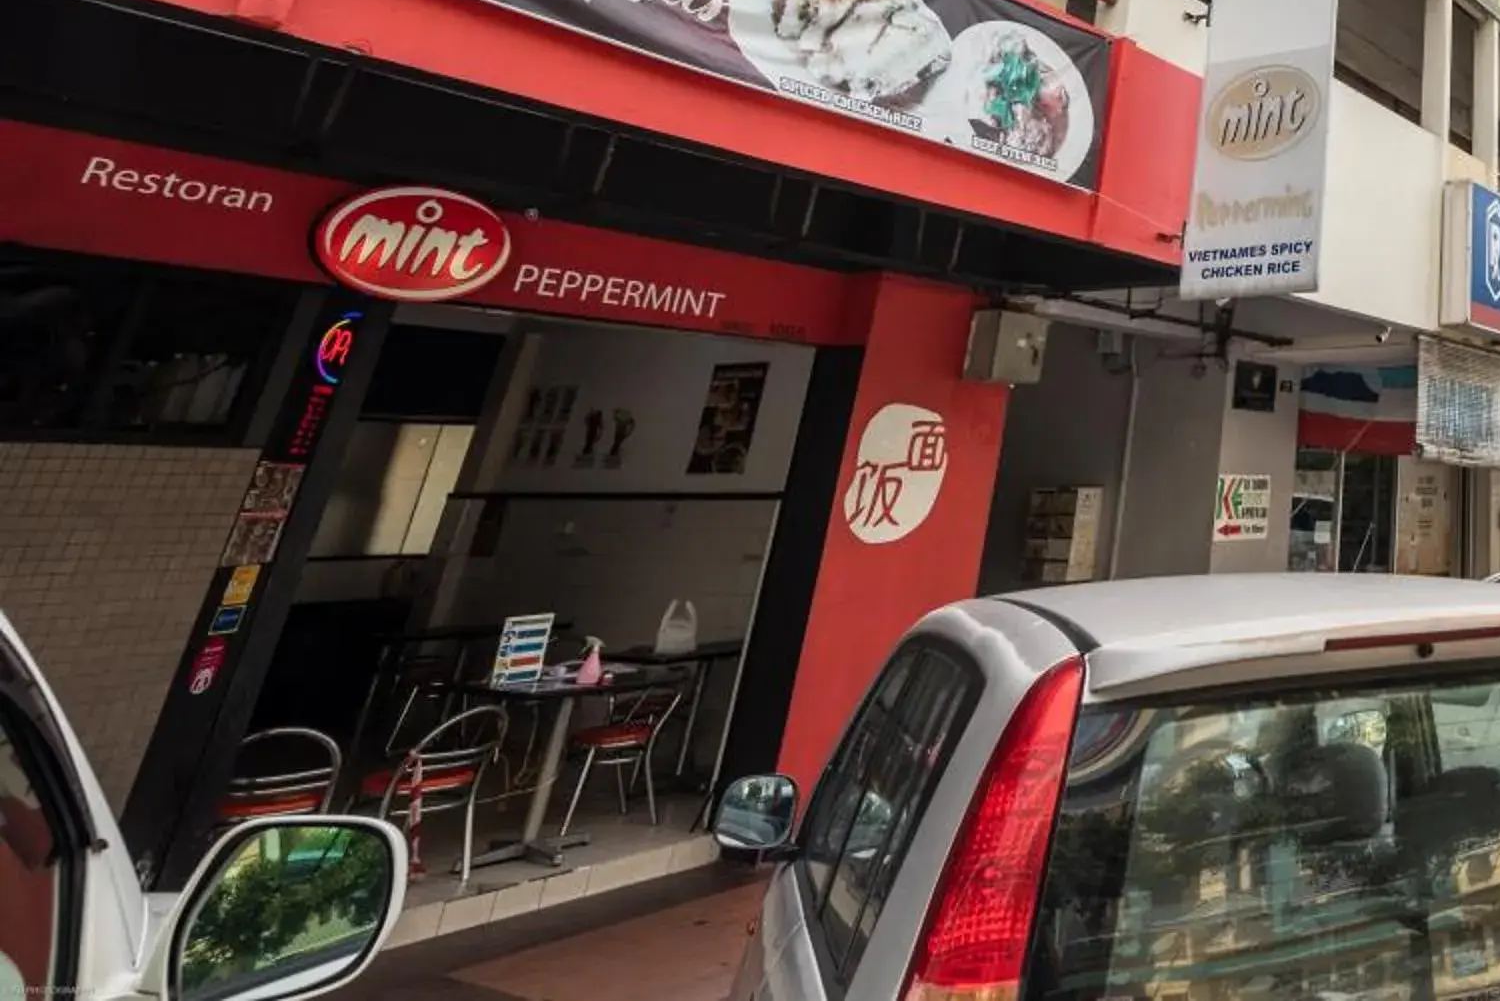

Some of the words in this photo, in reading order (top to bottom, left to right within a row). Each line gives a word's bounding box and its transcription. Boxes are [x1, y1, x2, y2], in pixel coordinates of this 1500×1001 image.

[1217, 71, 1306, 147] mint
[81, 156, 274, 214] Restoran
[338, 199, 489, 280] mint
[1188, 244, 1266, 262] VIETNAMES
[1271, 240, 1313, 256] SPICY
[513, 264, 726, 319] PEPPERMINT
[1201, 264, 1263, 280] CHICKEN
[1267, 260, 1301, 275] RICE
